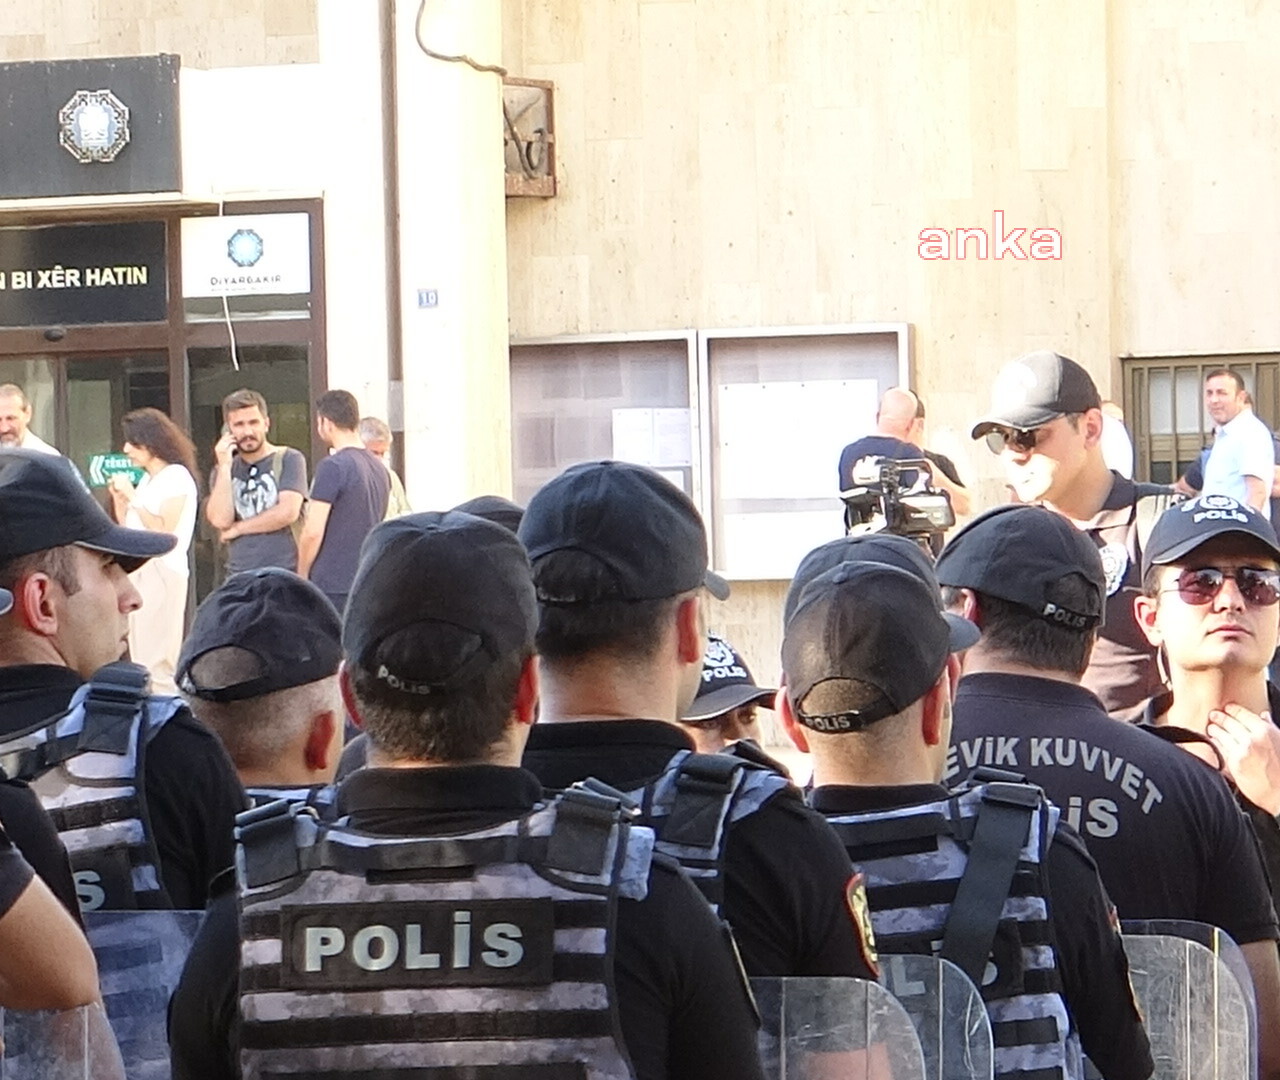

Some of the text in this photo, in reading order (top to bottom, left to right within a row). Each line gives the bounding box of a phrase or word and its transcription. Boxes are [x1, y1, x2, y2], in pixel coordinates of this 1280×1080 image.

[11, 270, 34, 290] BI
[37, 264, 82, 289] XÊR
[86, 266, 149, 287] HATIN
[942, 735, 1164, 815] EVİK KUVVET
[304, 910, 525, 974] POLİS
